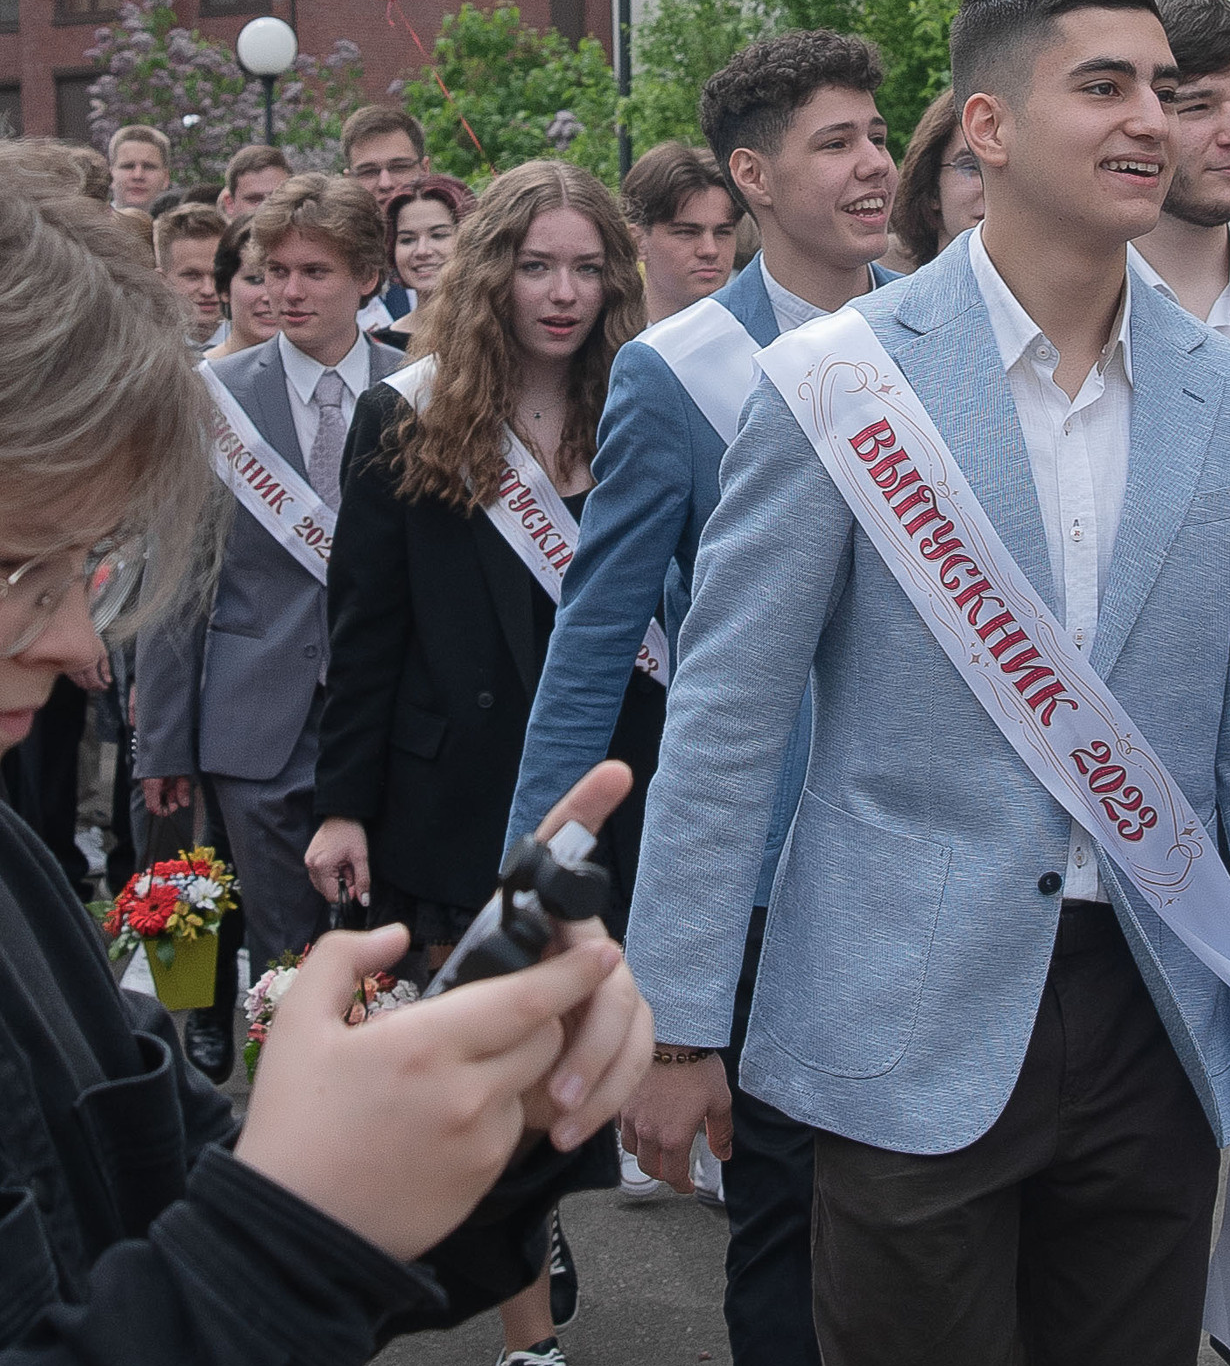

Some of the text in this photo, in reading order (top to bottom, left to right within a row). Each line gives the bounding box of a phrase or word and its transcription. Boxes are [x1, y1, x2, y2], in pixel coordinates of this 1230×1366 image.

[293, 515, 335, 566] 202
[498, 459, 575, 578] ПУСКН
[848, 416, 1158, 843] ВЫПУСКНИК 2023
